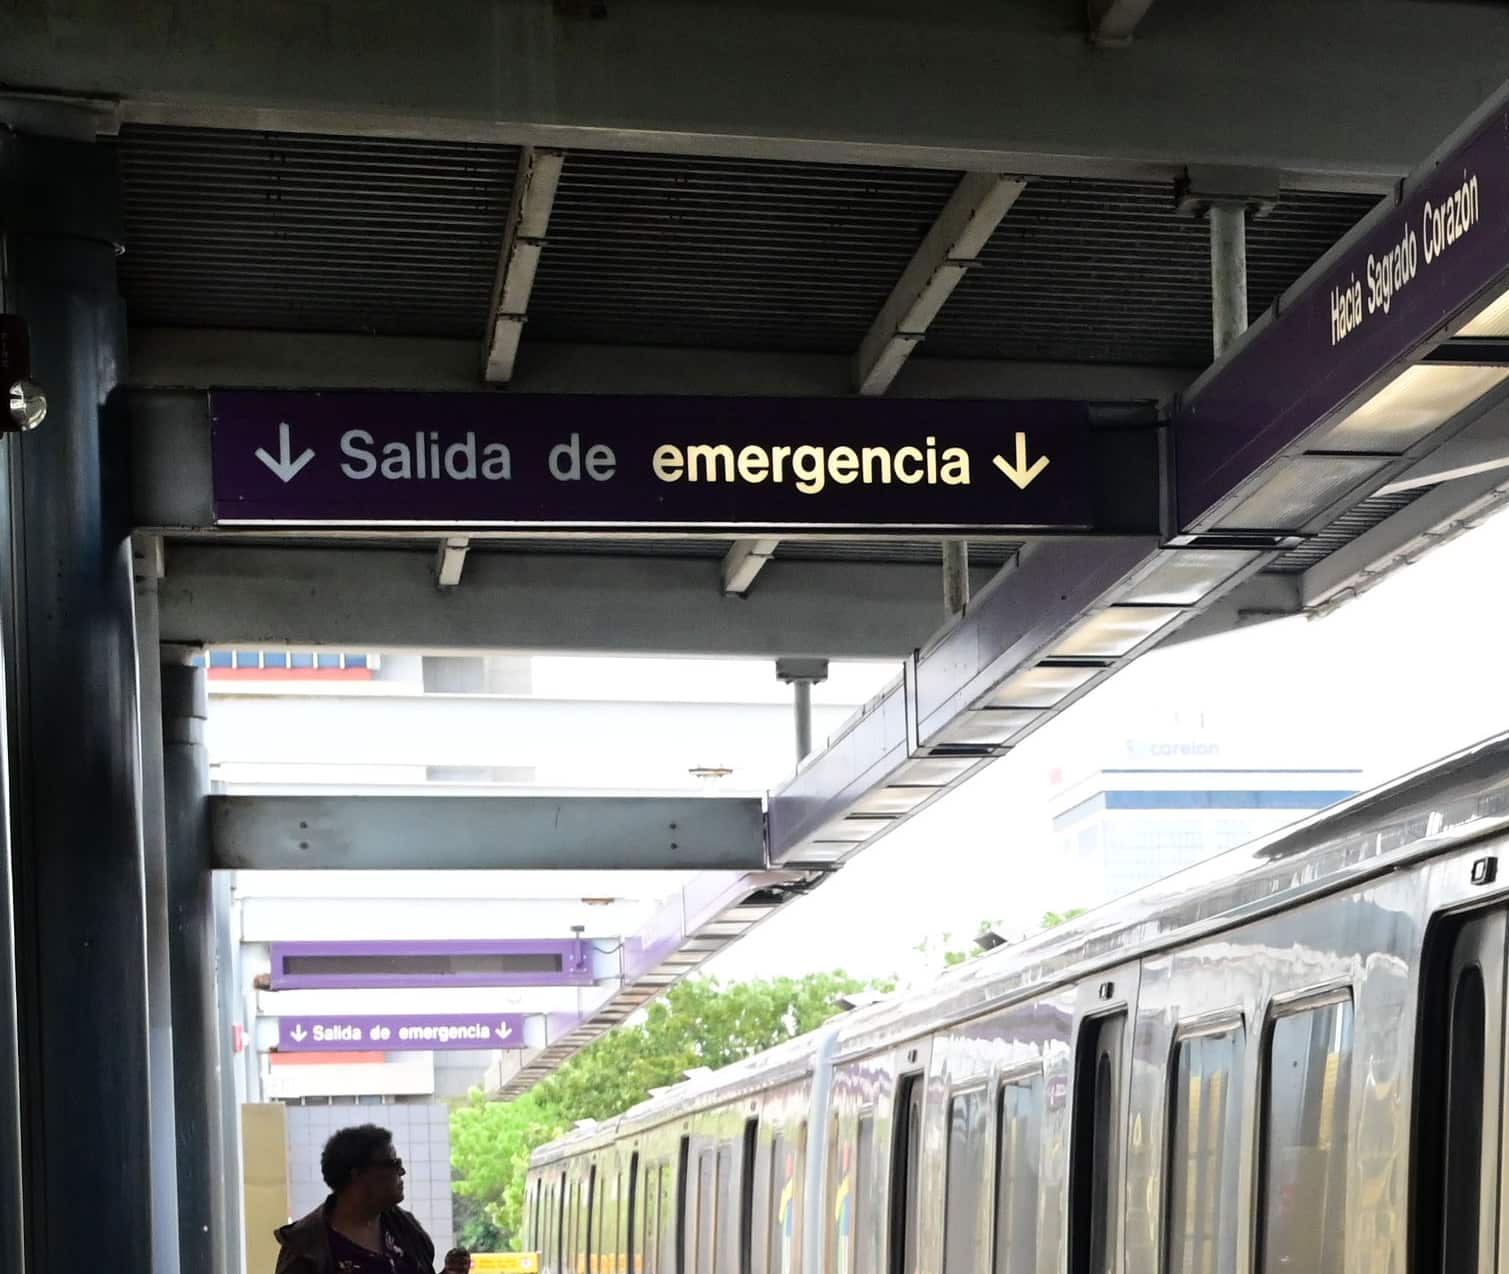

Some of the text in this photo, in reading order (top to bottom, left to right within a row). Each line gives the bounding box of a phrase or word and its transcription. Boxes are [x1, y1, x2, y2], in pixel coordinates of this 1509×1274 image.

[1330, 168, 1479, 346] Hacia Sagrado Corazón
[340, 430, 972, 495] Salida de emergencia
[312, 1023, 491, 1043] Salida de emergencia
